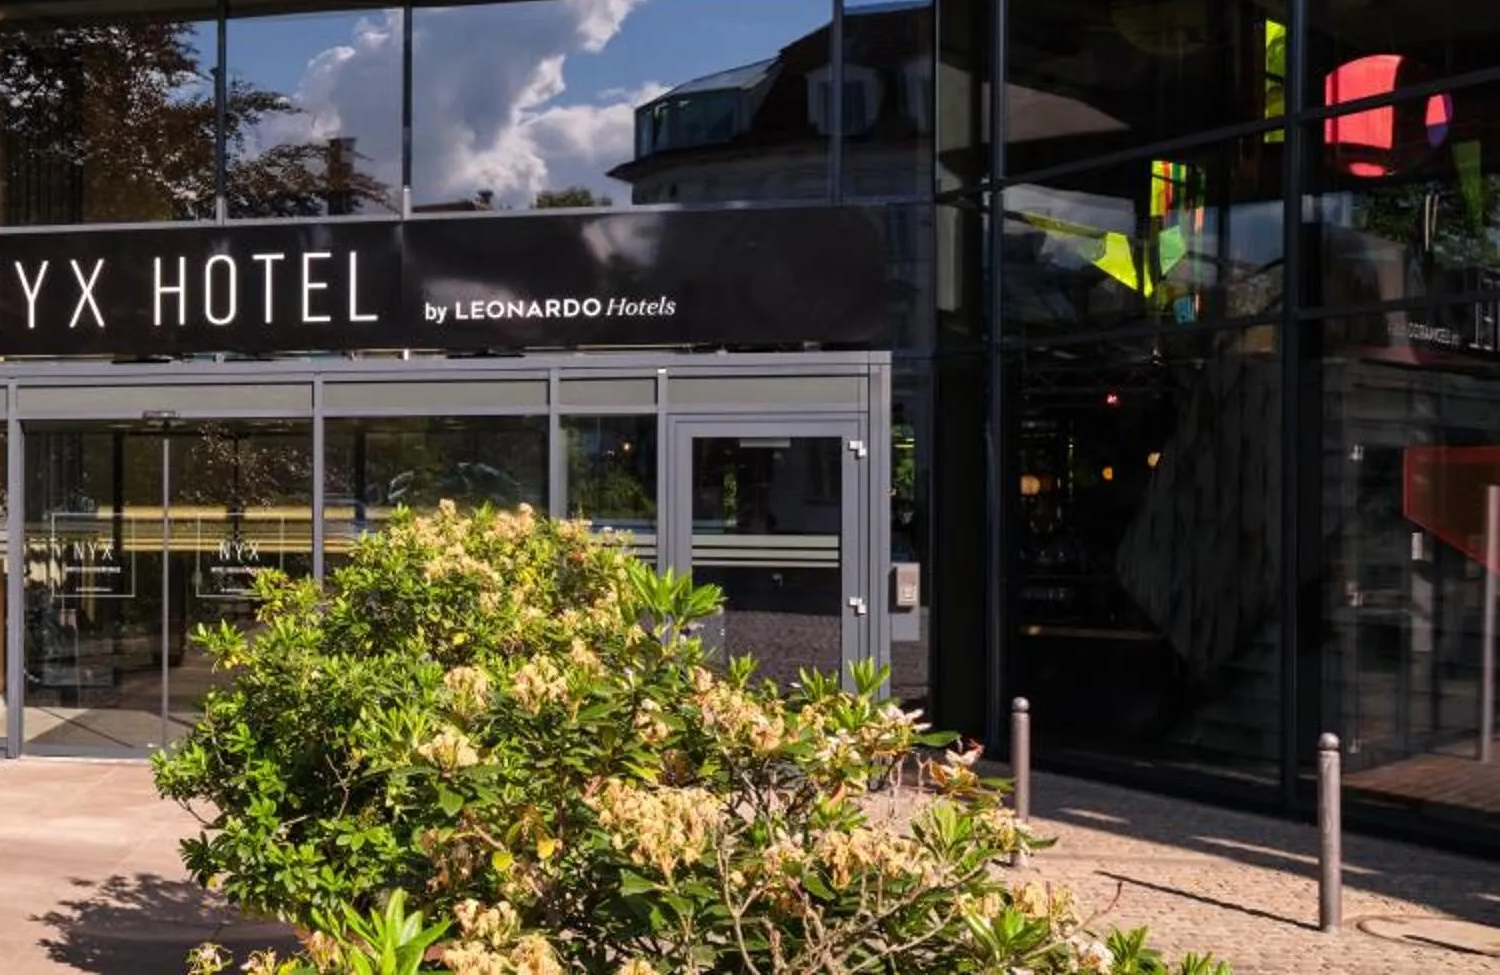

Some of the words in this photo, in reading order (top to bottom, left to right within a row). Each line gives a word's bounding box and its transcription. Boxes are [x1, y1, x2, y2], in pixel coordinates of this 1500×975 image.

[153, 250, 378, 326] HOTEL
[424, 301, 449, 325] by
[454, 297, 602, 320] LEONARDO
[606, 296, 676, 316] Hotels
[73, 541, 113, 561] NYX
[218, 540, 260, 561] NYX
